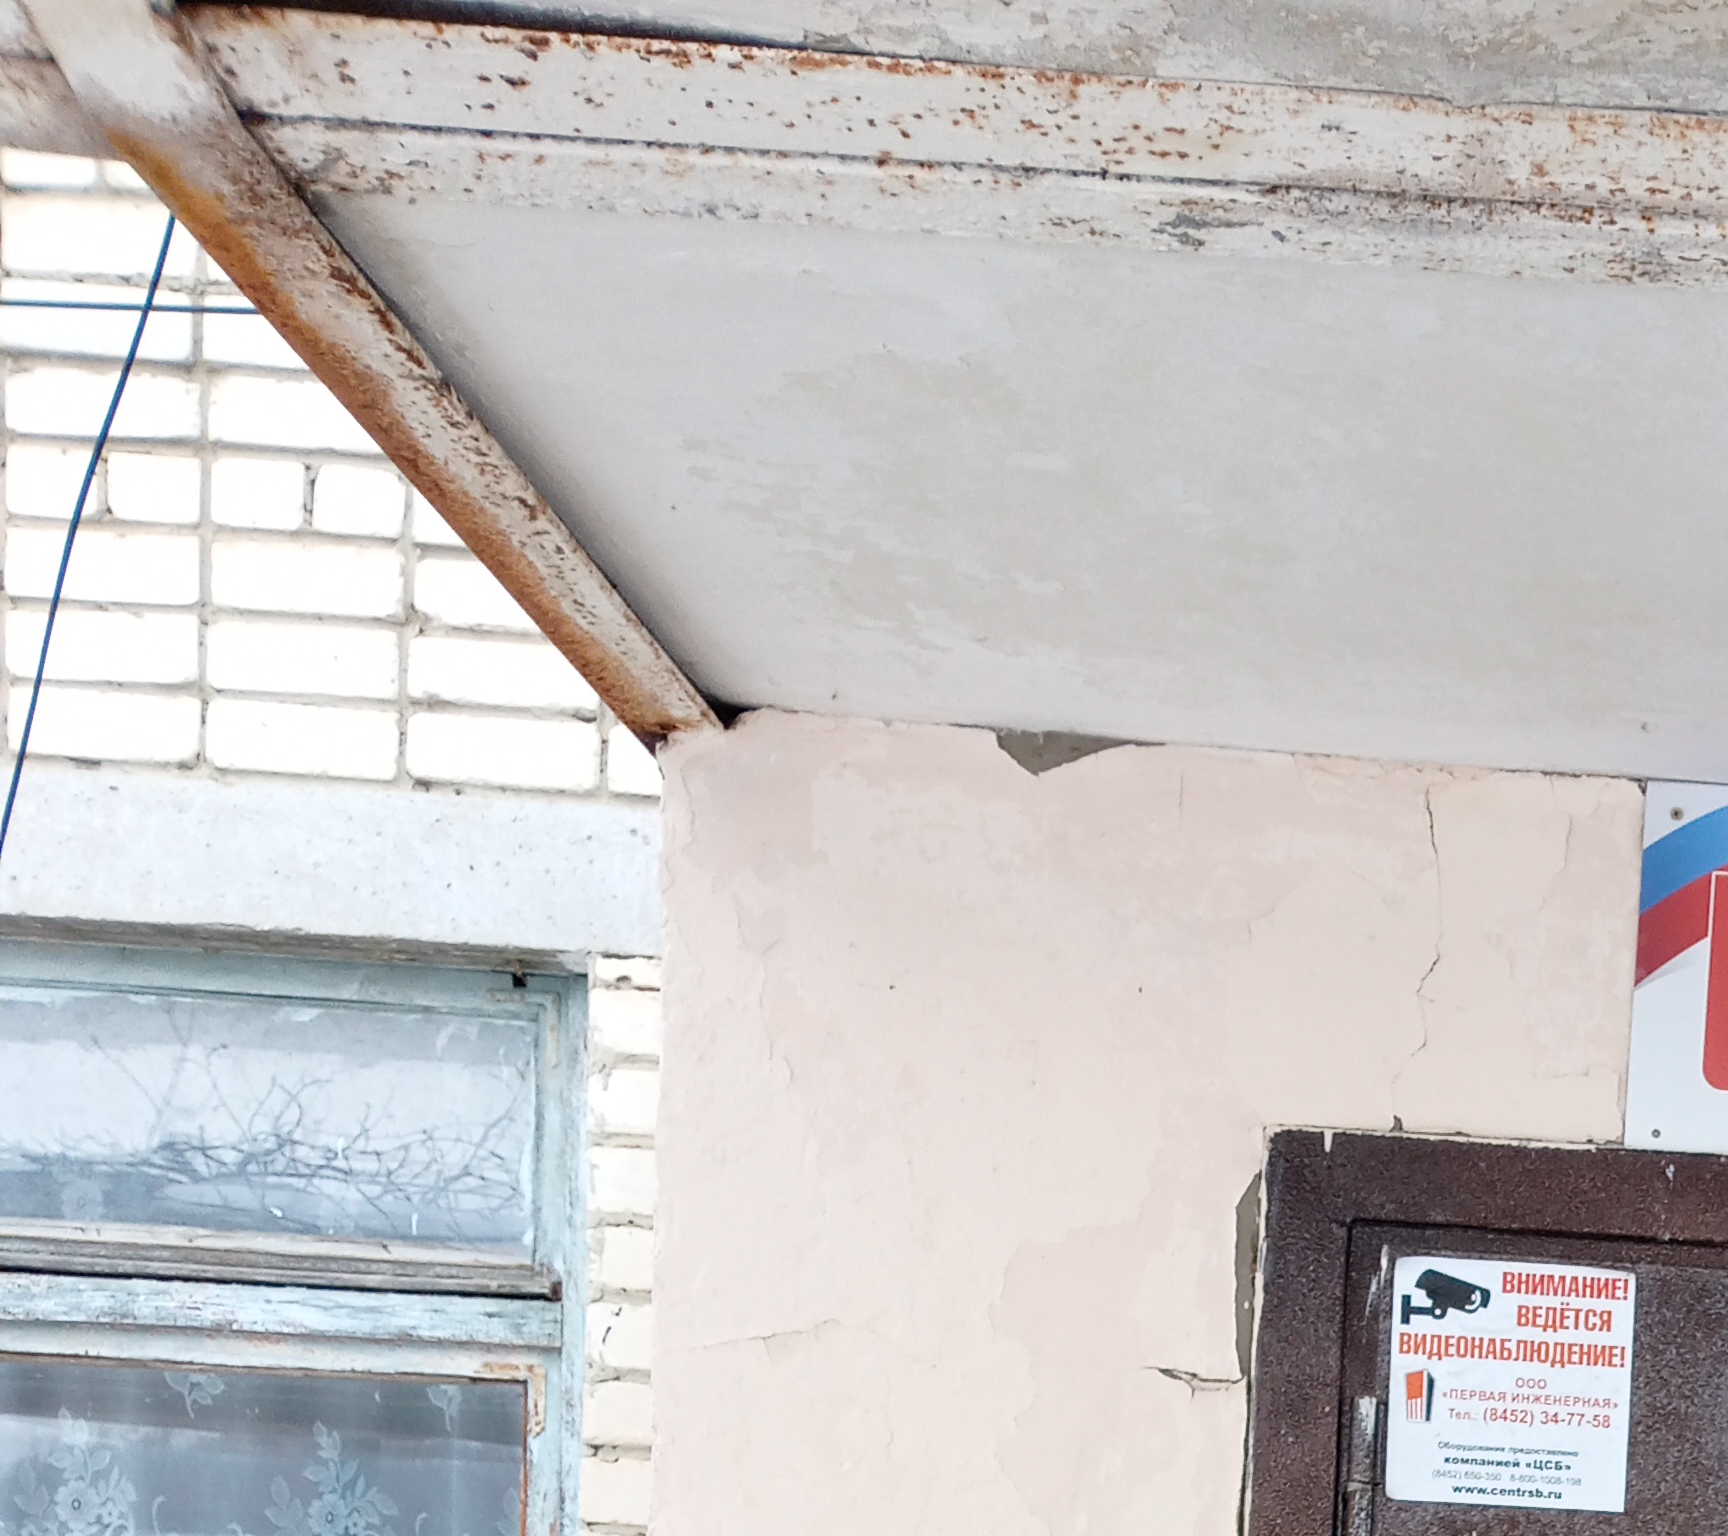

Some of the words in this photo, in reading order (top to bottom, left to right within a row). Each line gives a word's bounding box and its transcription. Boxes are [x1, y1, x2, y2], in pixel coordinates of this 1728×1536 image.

[1501, 1271, 1629, 1301] ВНИМАНИЕ!
[1516, 1302, 1612, 1332] ВЕДЁТСЯ
[1398, 1332, 1626, 1369] ВИДЕОНАБЛЮДЕНИЕ!
[1515, 1377, 1547, 1390] ООО
[1442, 1388, 1507, 1403] «ПЕРВАЯ
[1511, 1393, 1619, 1410] ИНЖЕНЕРНАЯ»
[1483, 1407, 1534, 1427] (8452)
[1540, 1411, 1611, 1429] 34-77-58
[1444, 1457, 1520, 1469] компанией
[1452, 1485, 1562, 1500] www.centrsb.ru
